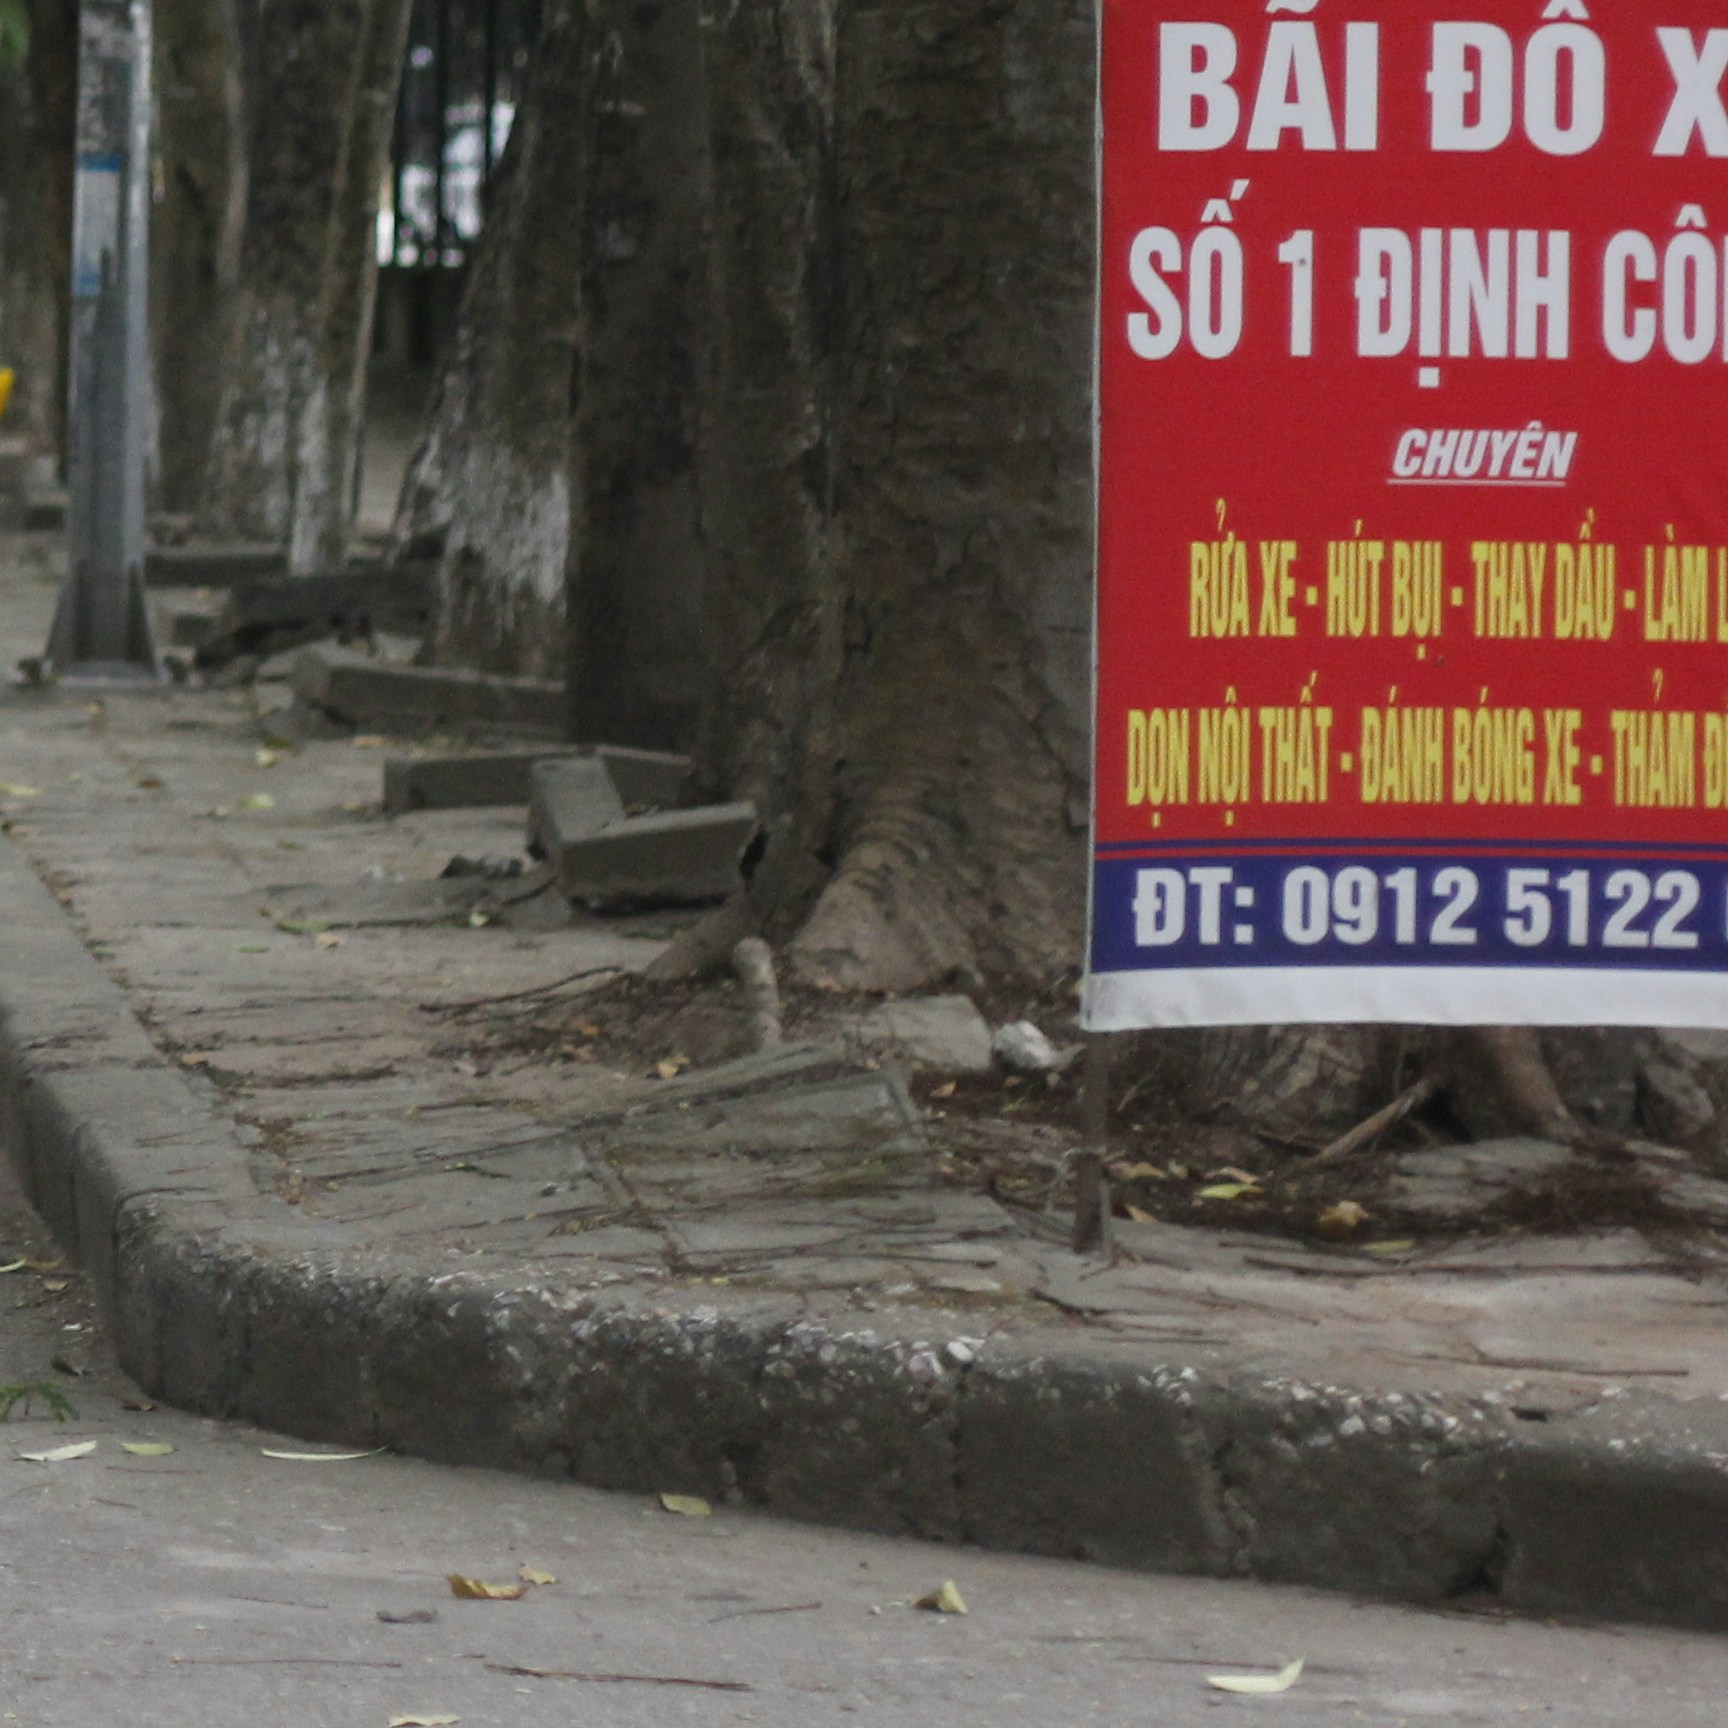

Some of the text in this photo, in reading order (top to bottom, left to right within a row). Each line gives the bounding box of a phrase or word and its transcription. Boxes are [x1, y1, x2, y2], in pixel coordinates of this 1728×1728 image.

[1126, 178, 1728, 388] SỐ 1 ĐỊNH CÔ
[1388, 420, 1578, 478] CHUYÊN
[1189, 498, 1250, 638] RỬA
[1258, 540, 1297, 637] XE
[1326, 519, 1385, 638] HÚT
[1391, 540, 1442, 660] BỤI
[1471, 541, 1547, 638] THAY
[1554, 508, 1615, 641] DẦU
[1644, 524, 1709, 642] LÀM
[1126, 707, 1190, 828] DỌN
[1198, 686, 1251, 826] NỘI
[1258, 671, 1333, 803] THẤT
[1360, 685, 1444, 803] ĐÁNH
[1452, 687, 1535, 805] BÓNG
[1543, 709, 1582, 805] XE
[1610, 669, 1695, 807] THẢM
[1131, 866, 1255, 947] ĐT:
[1282, 865, 1479, 945] 0912
[1503, 868, 1700, 948] 5122
